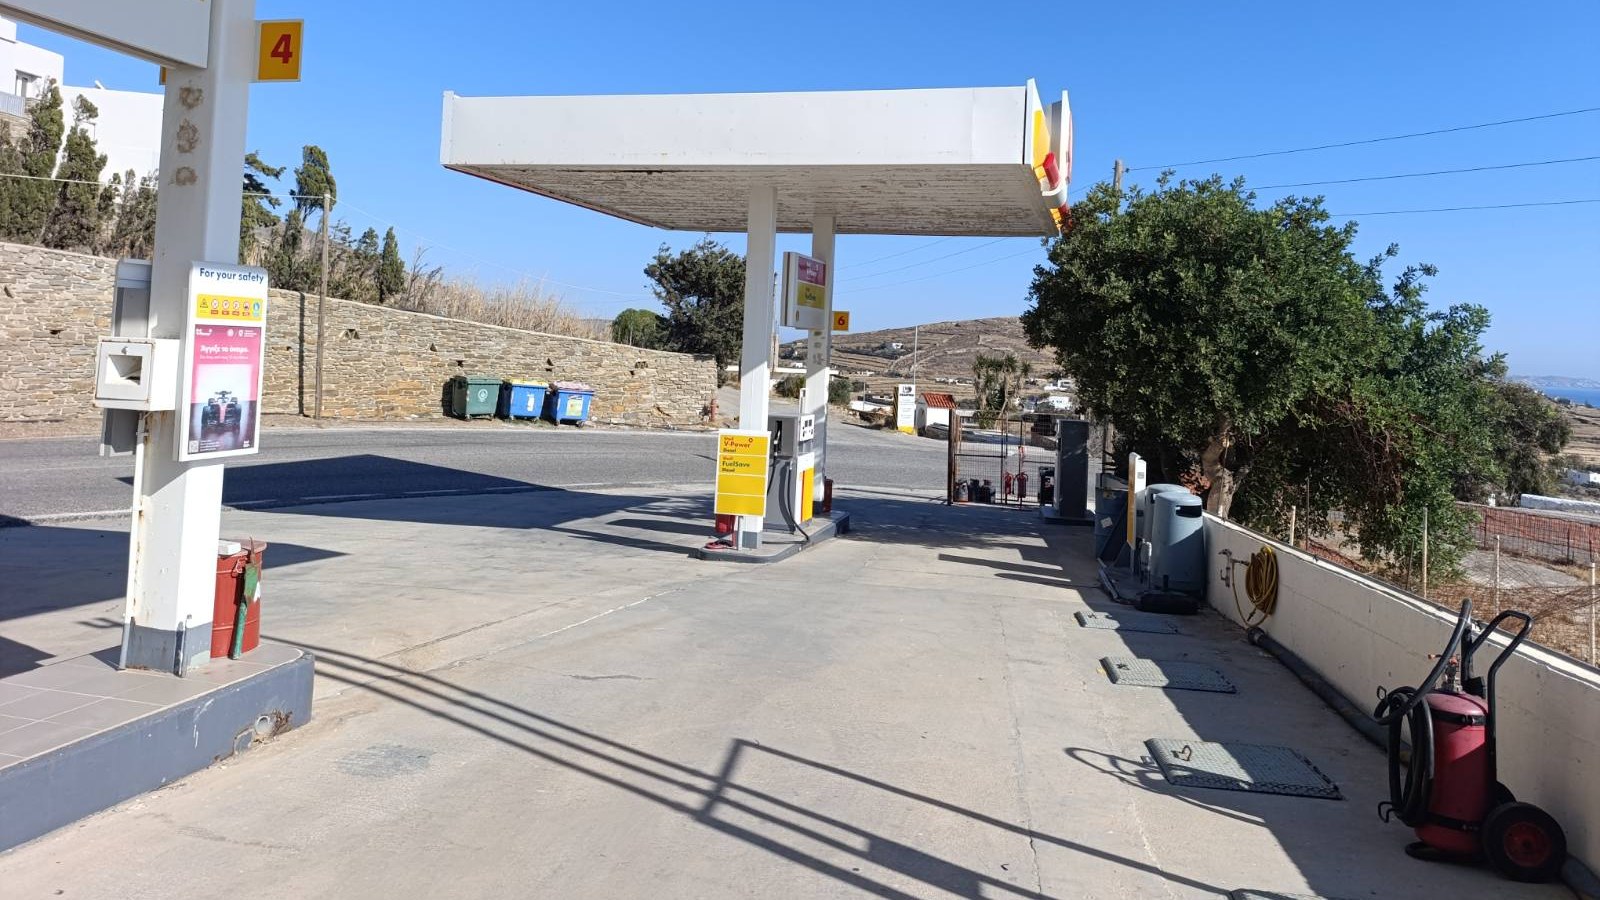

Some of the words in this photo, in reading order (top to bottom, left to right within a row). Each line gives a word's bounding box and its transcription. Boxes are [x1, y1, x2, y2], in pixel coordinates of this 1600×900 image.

[271, 34, 293, 64] 4
[200, 268, 214, 278] For
[217, 271, 236, 280] your
[238, 272, 264, 284] safety
[838, 316, 845, 326] 6
